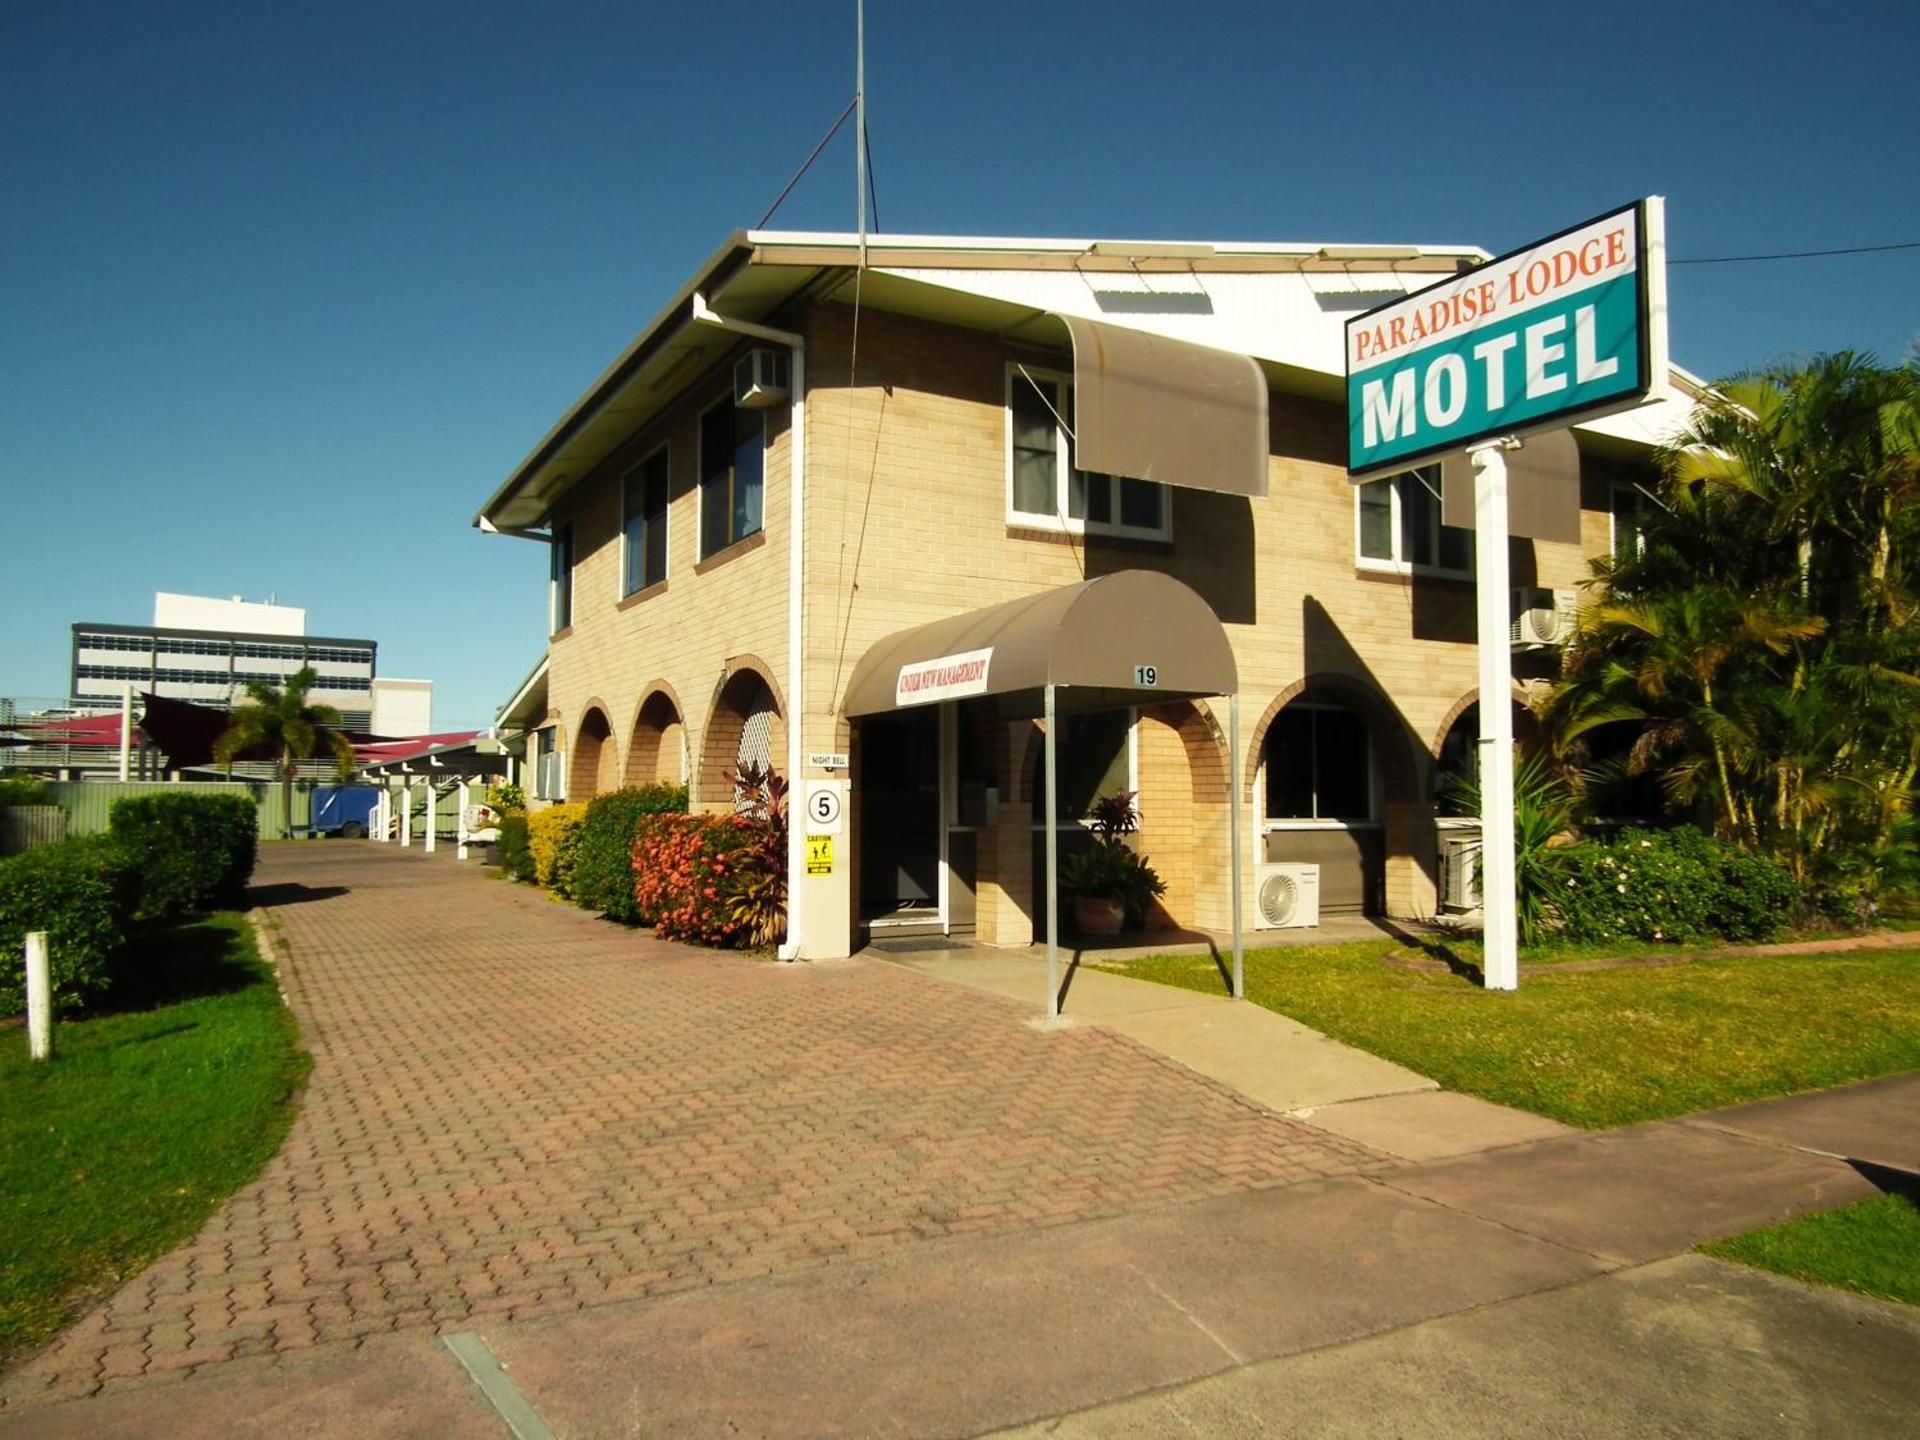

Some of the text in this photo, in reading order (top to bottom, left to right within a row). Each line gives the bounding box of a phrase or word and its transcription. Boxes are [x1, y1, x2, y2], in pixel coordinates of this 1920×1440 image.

[1355, 228, 1627, 361] PARADISE LODGE
[1362, 304, 1619, 449] MOTEL
[936, 659, 986, 687] MANAGEMENT
[1137, 667, 1156, 685] 19
[812, 756, 846, 765] NIGHT BELL
[818, 797, 831, 817] 5
